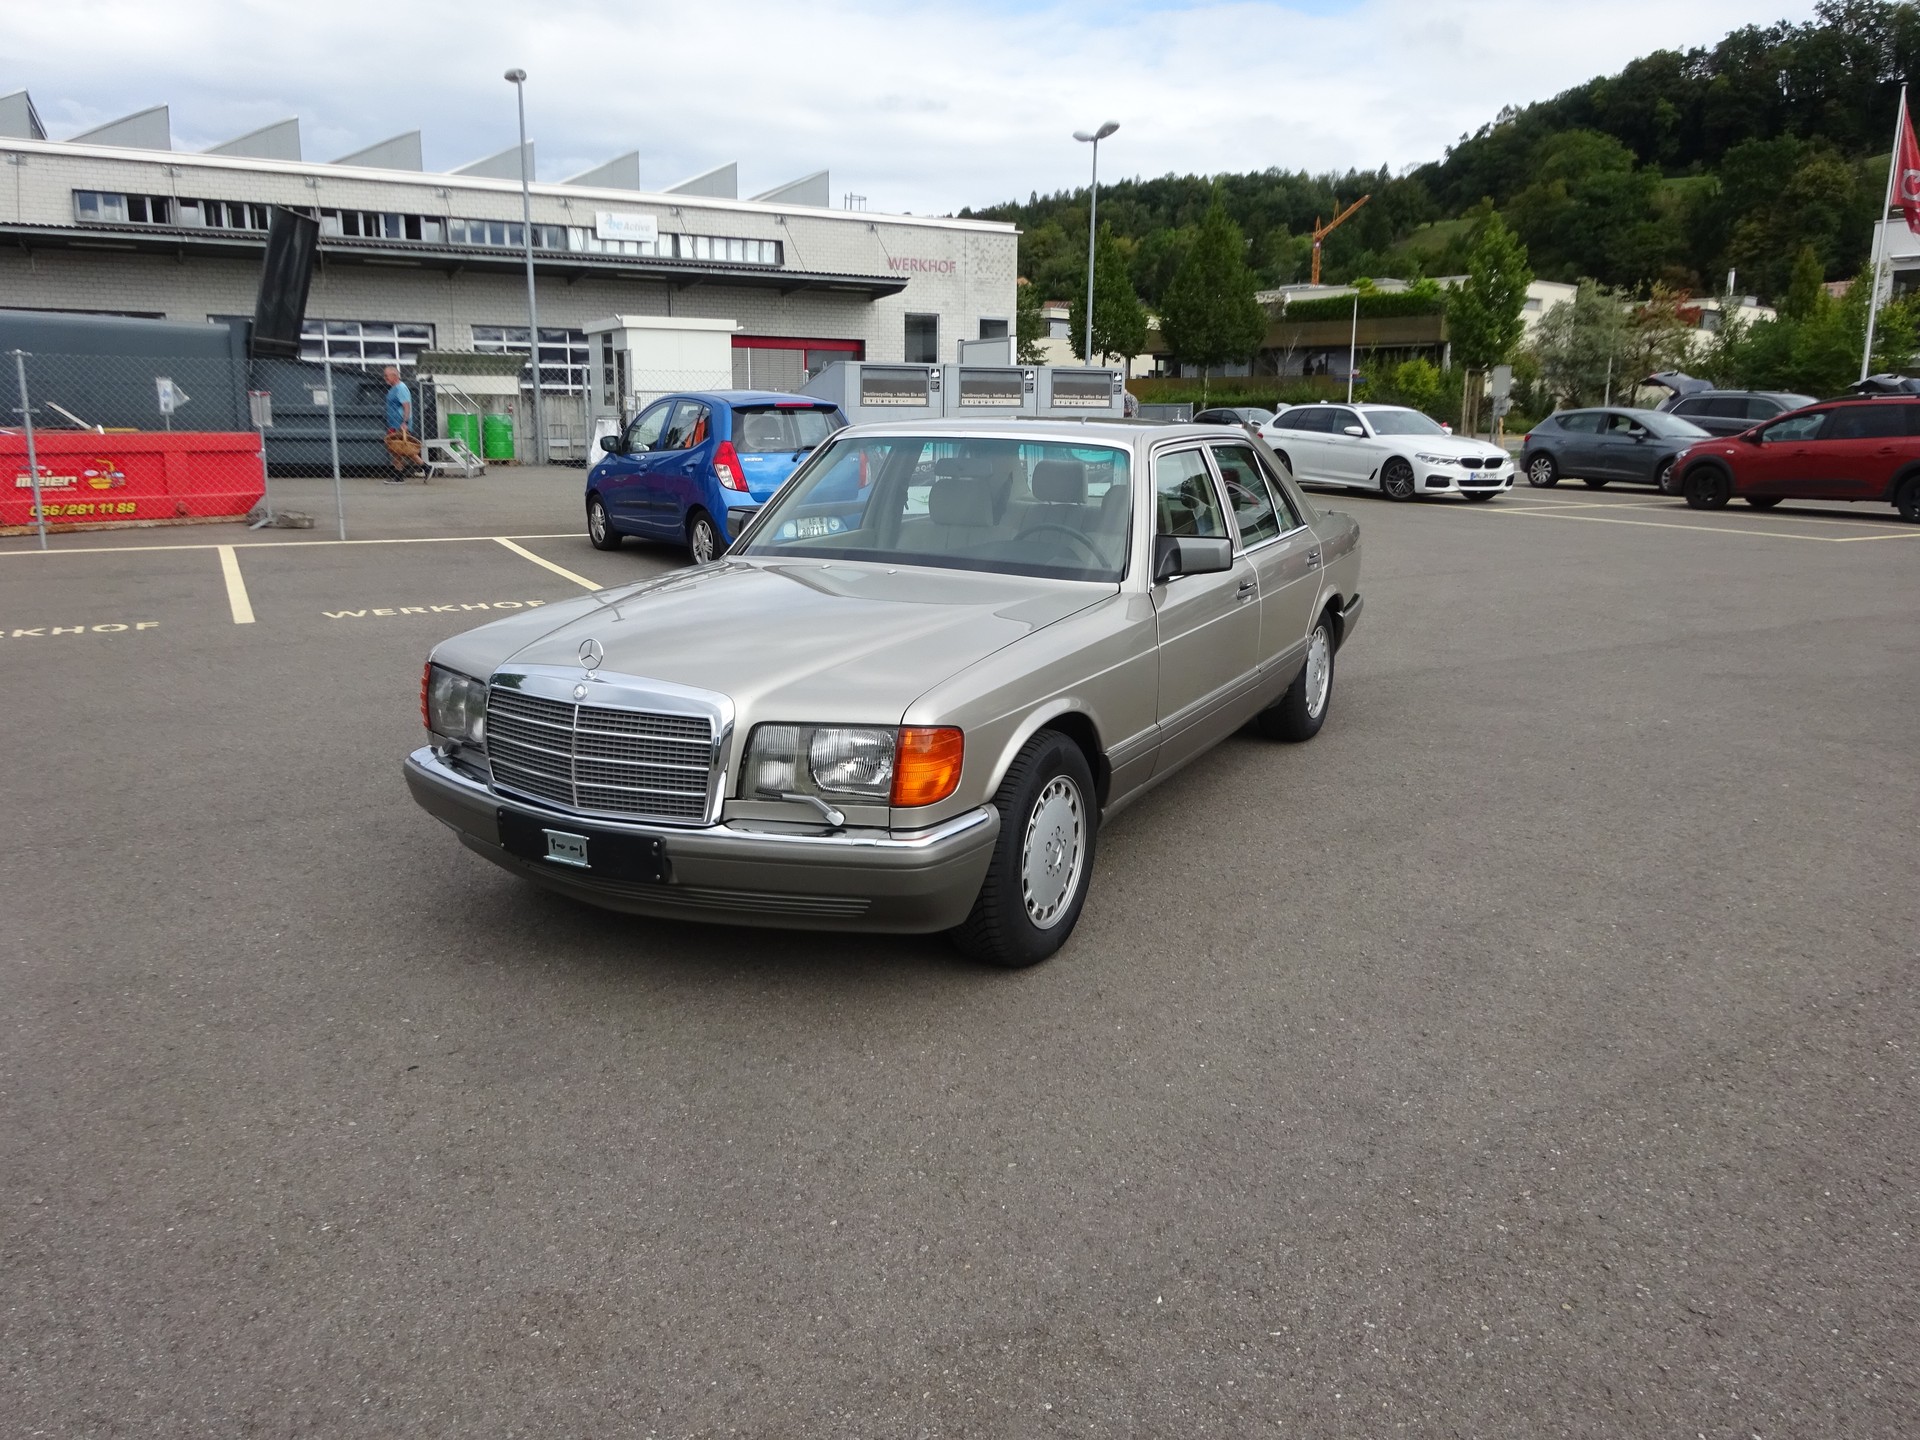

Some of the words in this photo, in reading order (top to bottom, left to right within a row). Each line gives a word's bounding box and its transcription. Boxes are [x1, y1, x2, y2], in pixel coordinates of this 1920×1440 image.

[887, 256, 957, 274] WERKHOF
[99, 502, 114, 514] 11
[117, 502, 137, 514] 88
[321, 600, 546, 619] WERKHOF
[0, 621, 160, 638] KHOF
